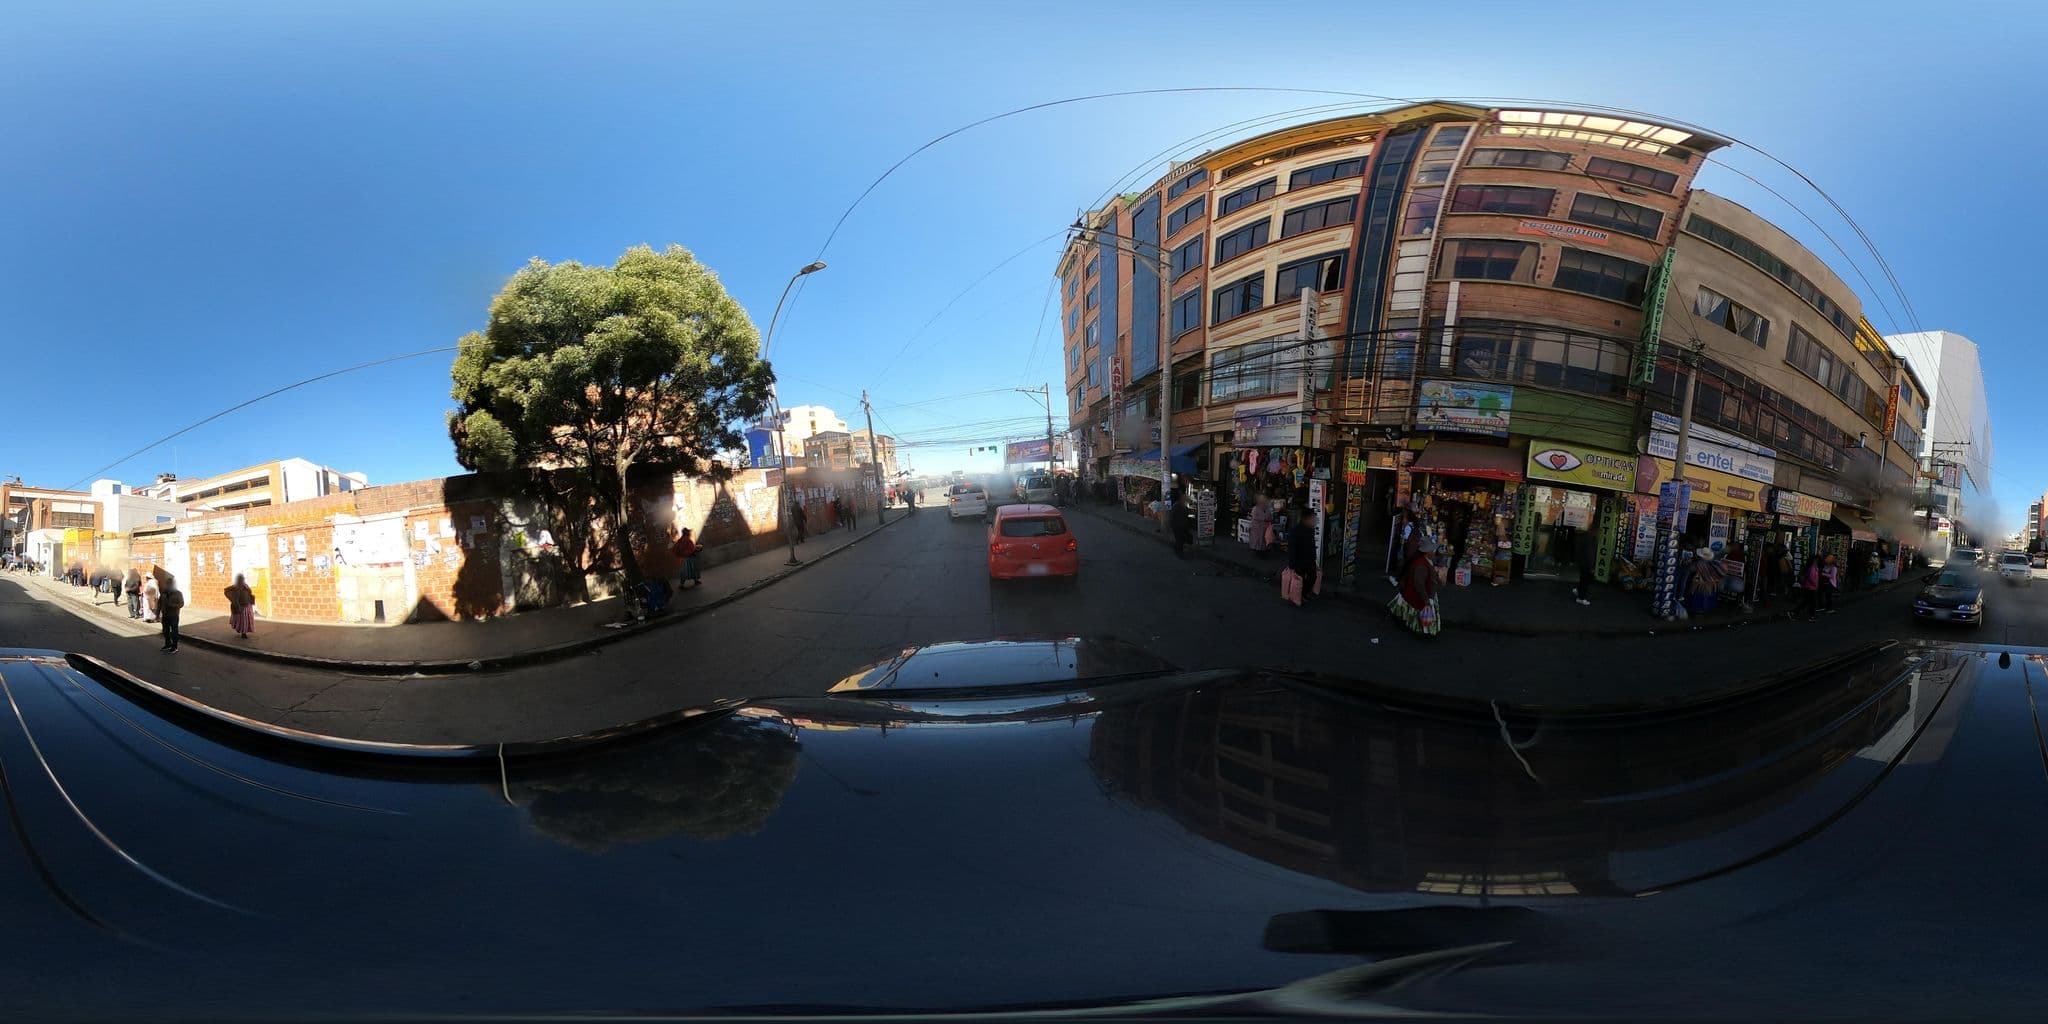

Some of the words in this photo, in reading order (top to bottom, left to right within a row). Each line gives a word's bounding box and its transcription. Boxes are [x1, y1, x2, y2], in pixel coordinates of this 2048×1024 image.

[1662, 247, 1675, 289] MEDICION
[1585, 452, 1635, 472] OPTICAS
[1697, 451, 1734, 471] entel
[1514, 494, 1525, 548] OPTICAS
[1524, 495, 1535, 549] OPTICAS
[1598, 505, 1611, 577] OPTICAS
[1661, 531, 1679, 616] FOTOCOPIAS
